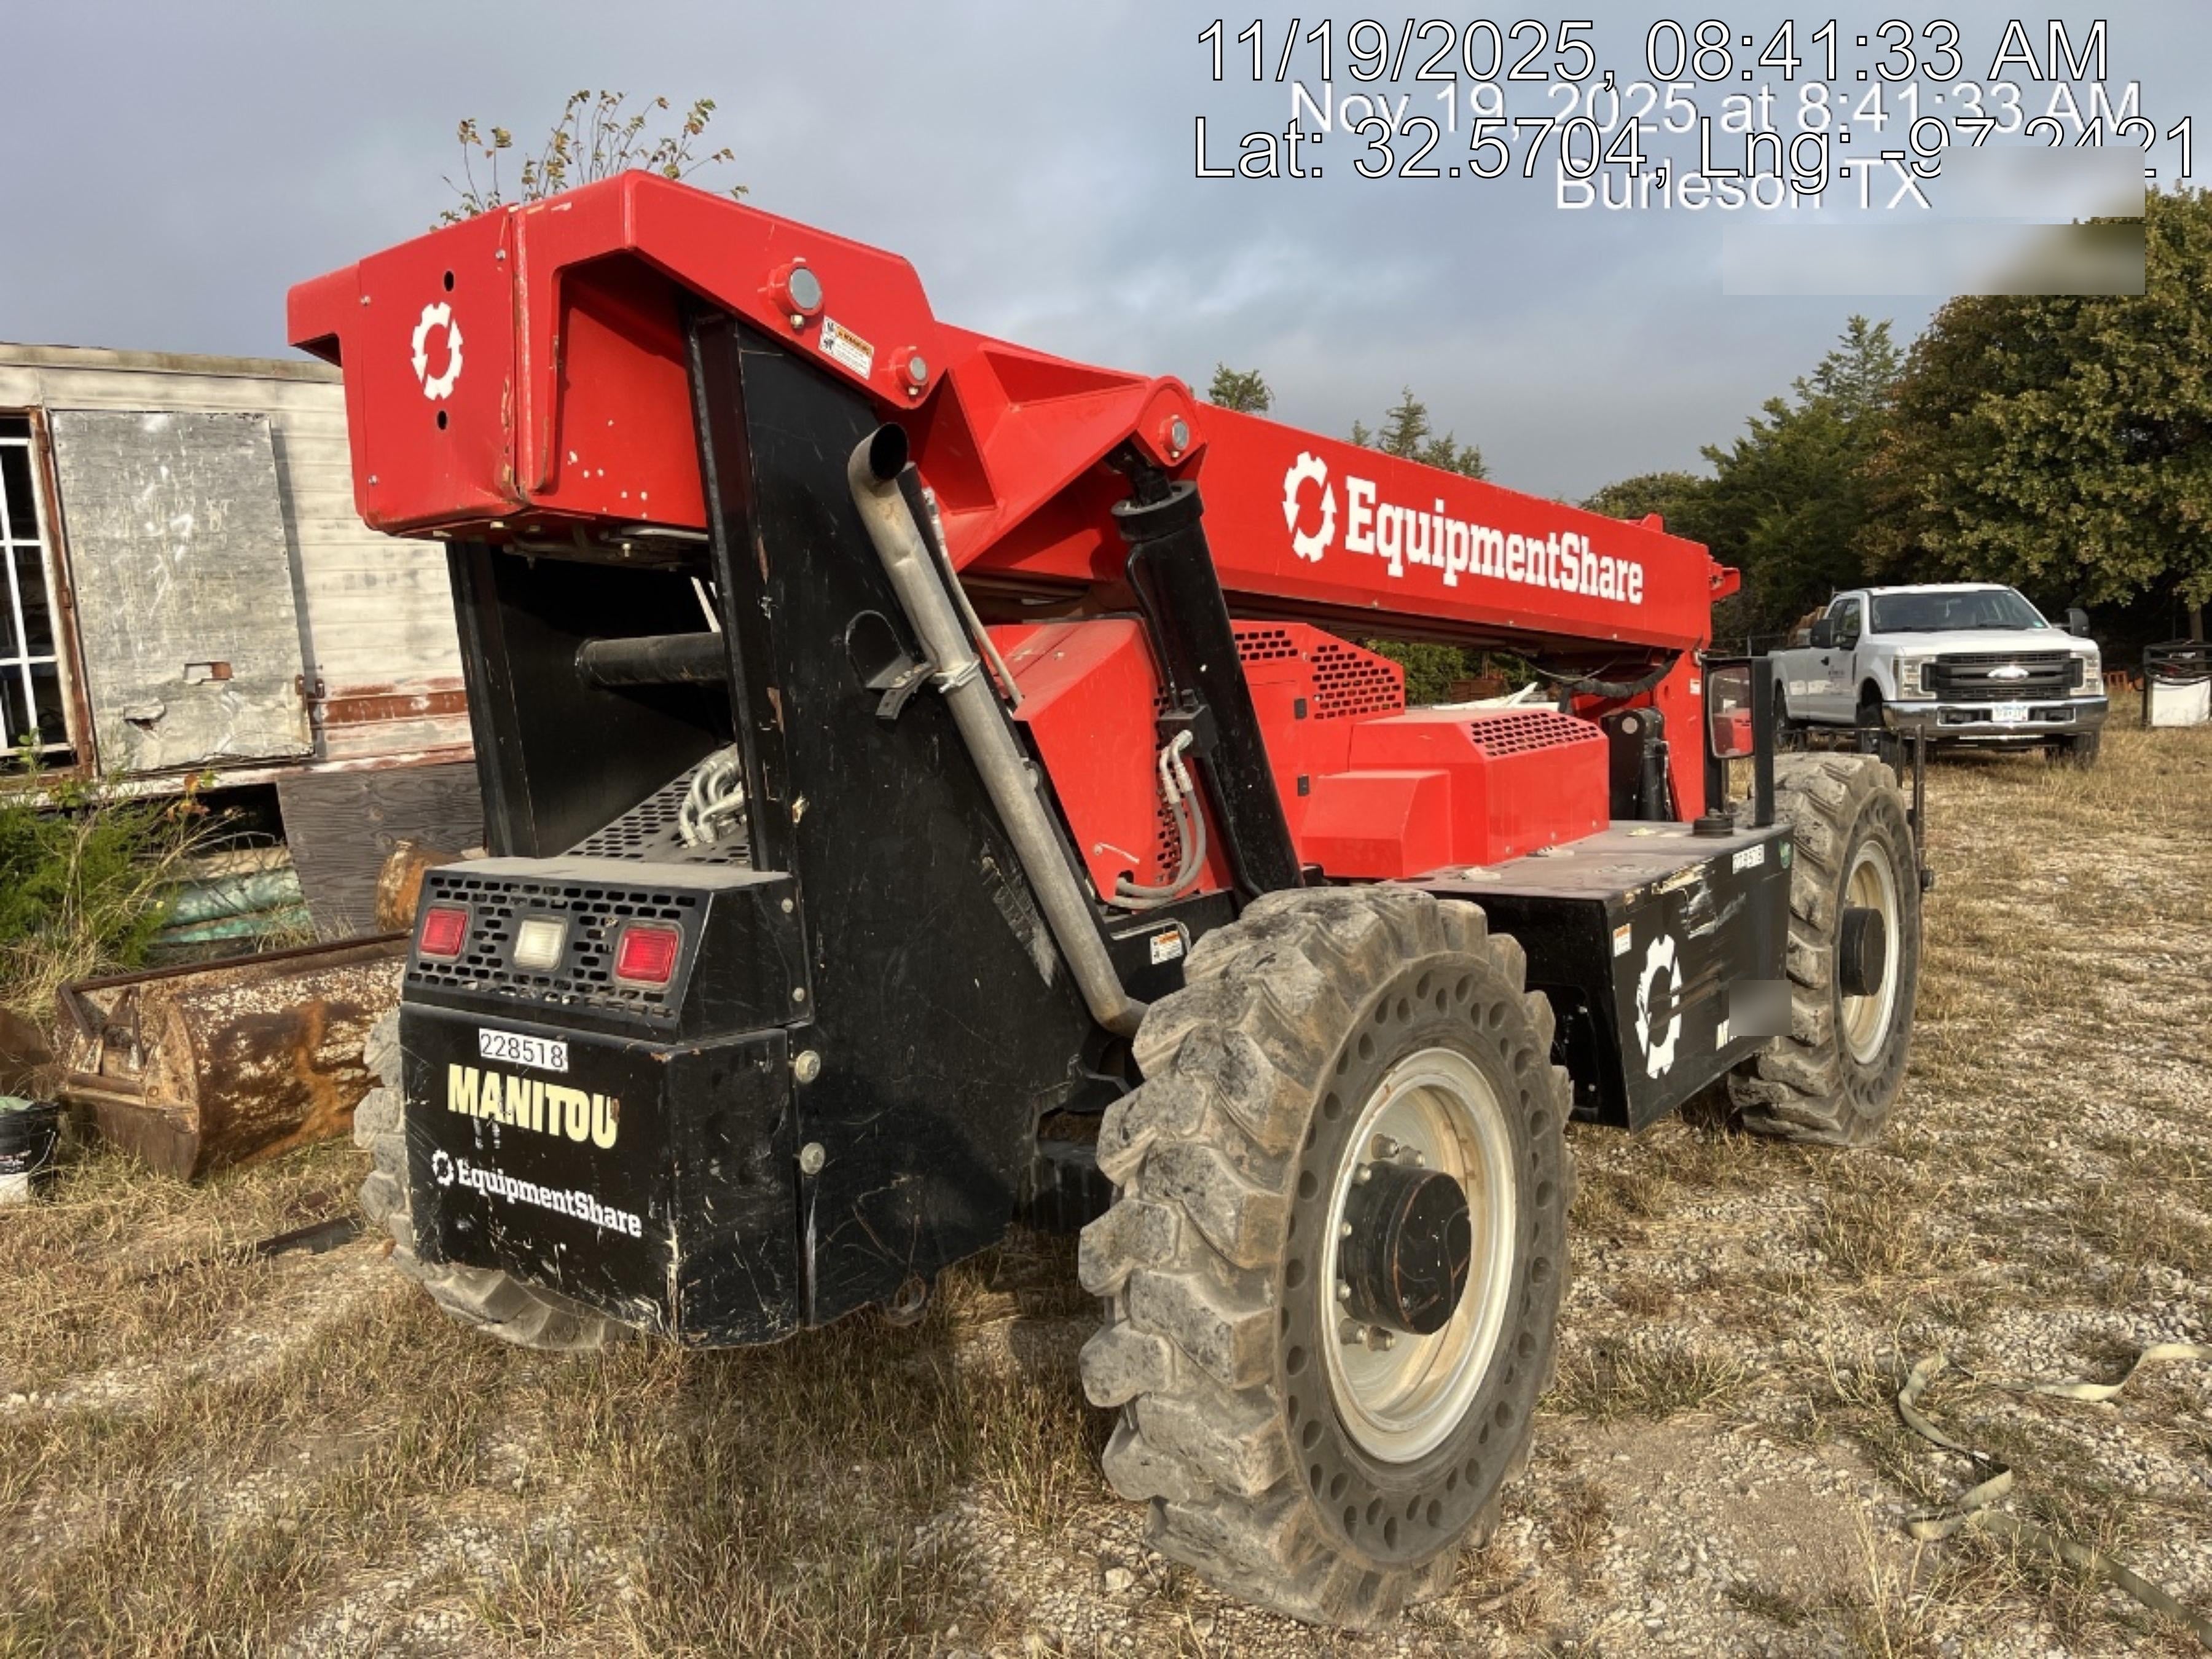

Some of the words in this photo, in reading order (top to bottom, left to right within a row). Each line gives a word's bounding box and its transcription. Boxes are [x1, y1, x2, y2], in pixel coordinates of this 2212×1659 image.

[1344, 475, 1644, 605] EquipmentShare
[480, 1033, 563, 1068] 228518
[447, 1063, 620, 1150] MANITOU
[457, 1157, 643, 1238] EquipmentShare
